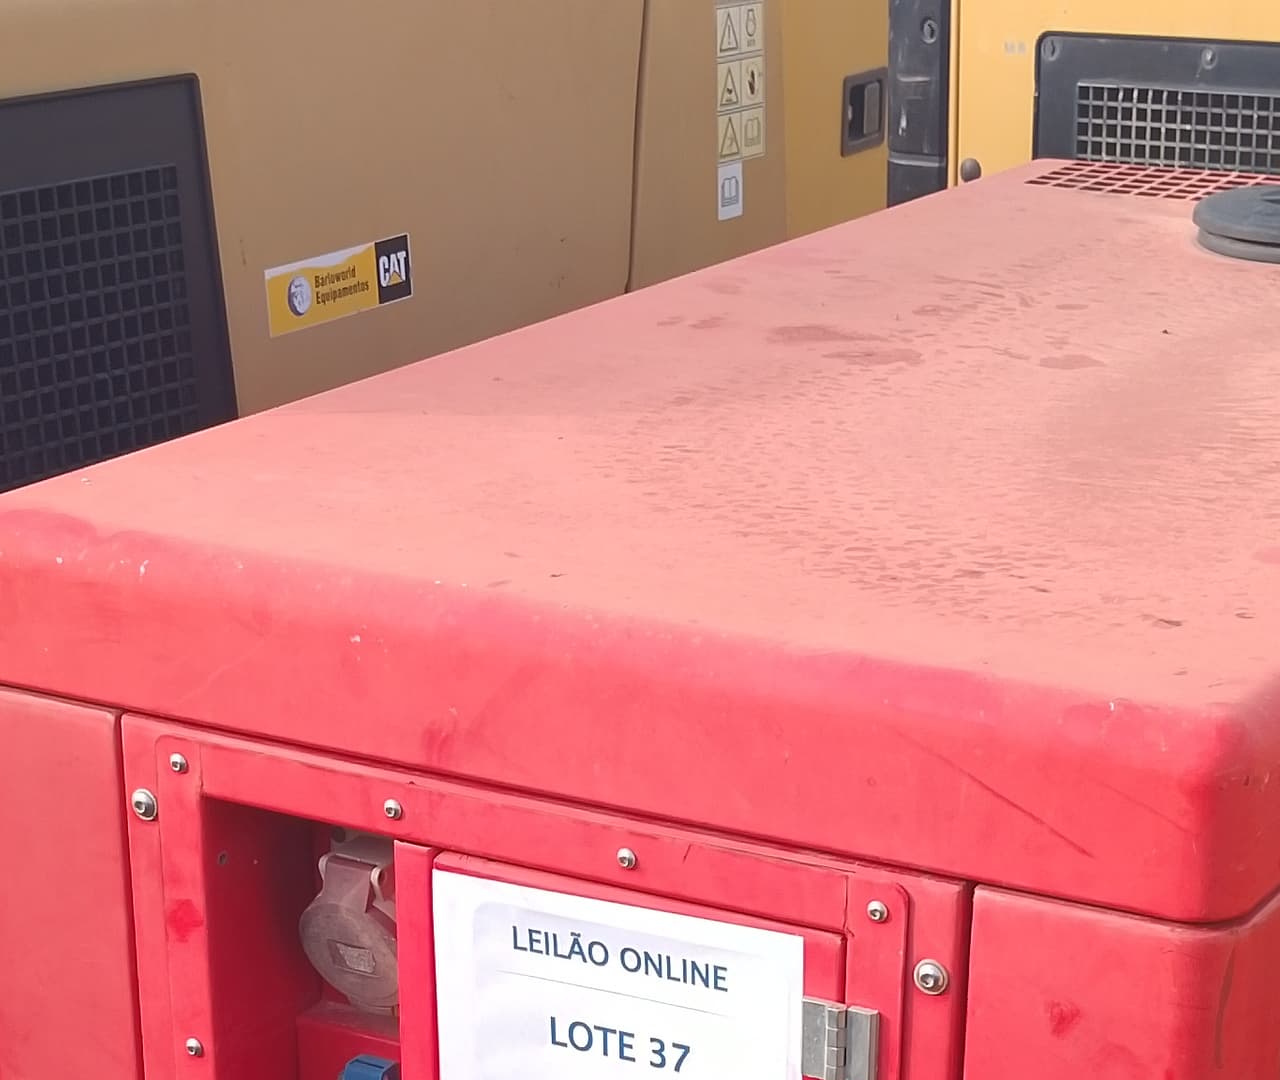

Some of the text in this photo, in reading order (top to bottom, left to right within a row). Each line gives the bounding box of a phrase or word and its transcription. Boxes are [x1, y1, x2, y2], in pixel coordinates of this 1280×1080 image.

[314, 265, 356, 288] Barloworld
[379, 250, 406, 288] CAT
[316, 280, 369, 304] Equipamentos
[512, 925, 729, 993] LEILÃO ONLINE
[550, 1015, 691, 1073] LOTE 37
